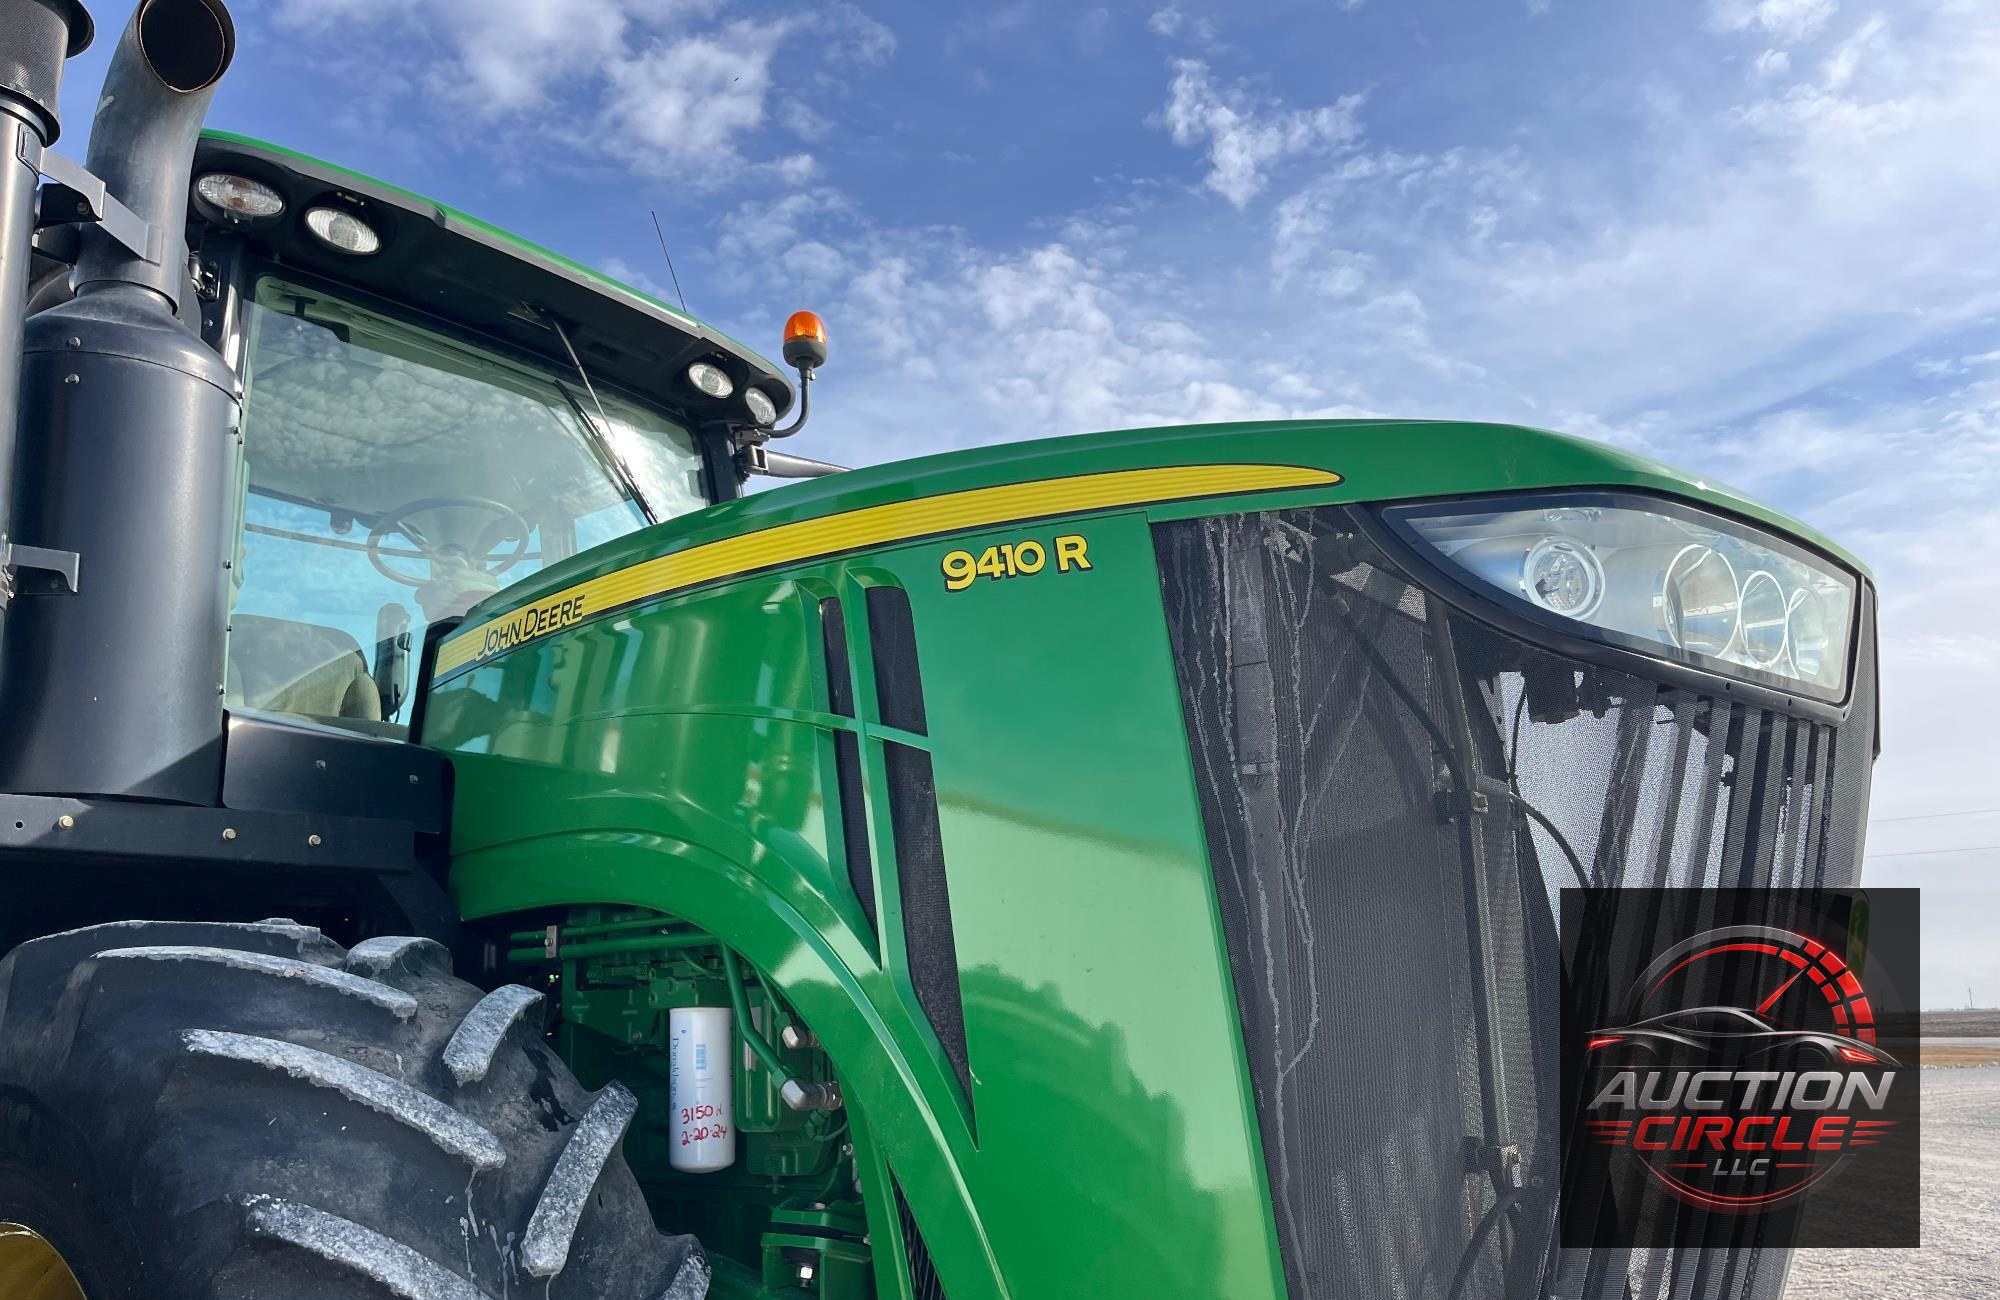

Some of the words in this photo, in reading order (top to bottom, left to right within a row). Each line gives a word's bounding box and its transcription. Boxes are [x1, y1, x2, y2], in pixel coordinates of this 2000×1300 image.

[941, 539, 1046, 592] 9410
[1053, 534, 1094, 574] R
[477, 618, 523, 655] JOHN
[523, 594, 585, 637] DEERE
[681, 1104, 714, 1125] 3150
[681, 1123, 728, 1146] 2-20-24
